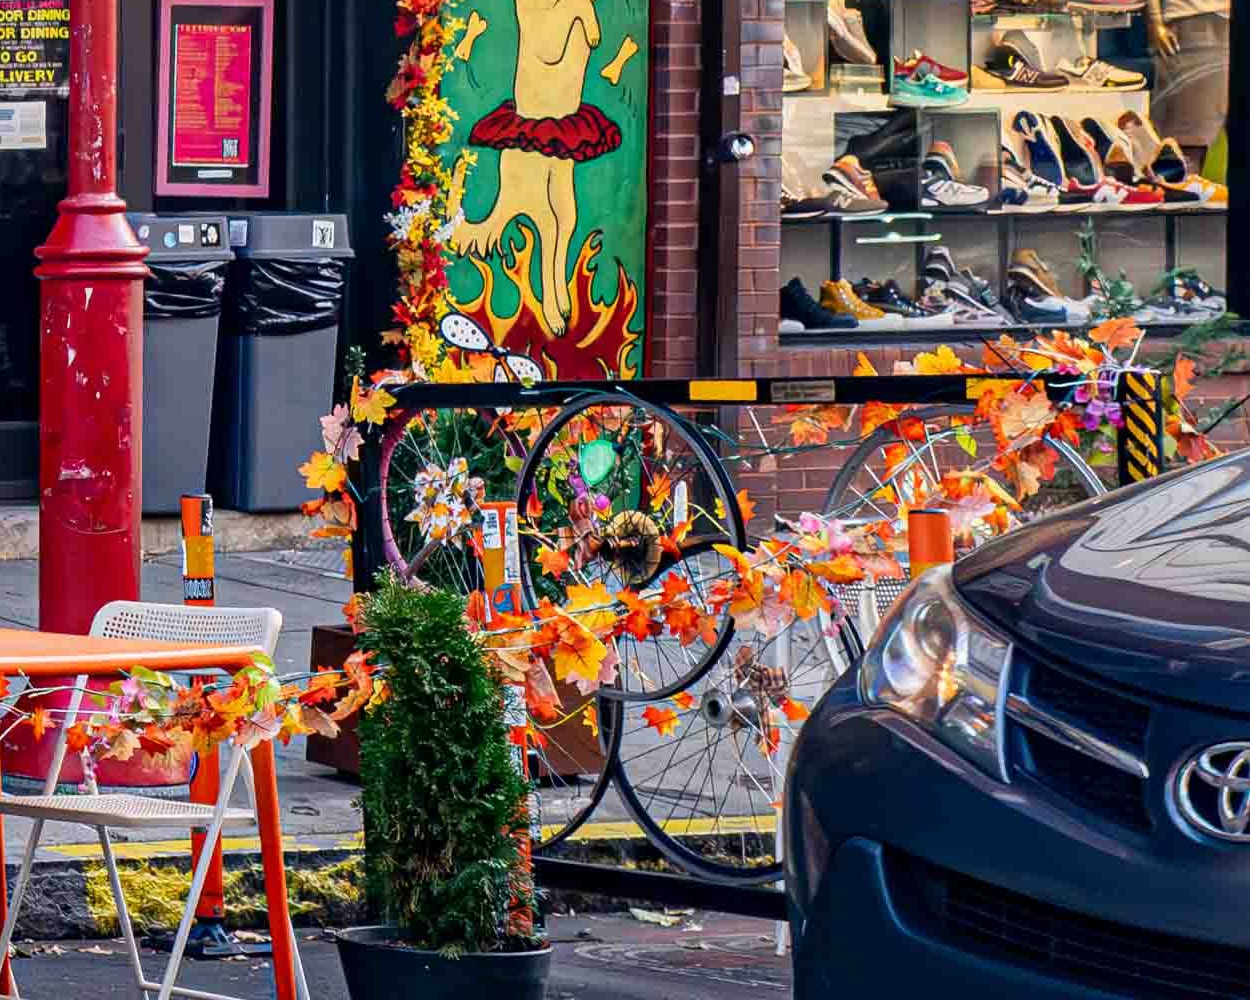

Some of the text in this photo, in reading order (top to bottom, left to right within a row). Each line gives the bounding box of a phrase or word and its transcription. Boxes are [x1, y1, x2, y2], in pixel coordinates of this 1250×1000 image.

[27, 8, 71, 22] DINING
[20, 26, 70, 40] DINING
[15, 51, 38, 63] GO
